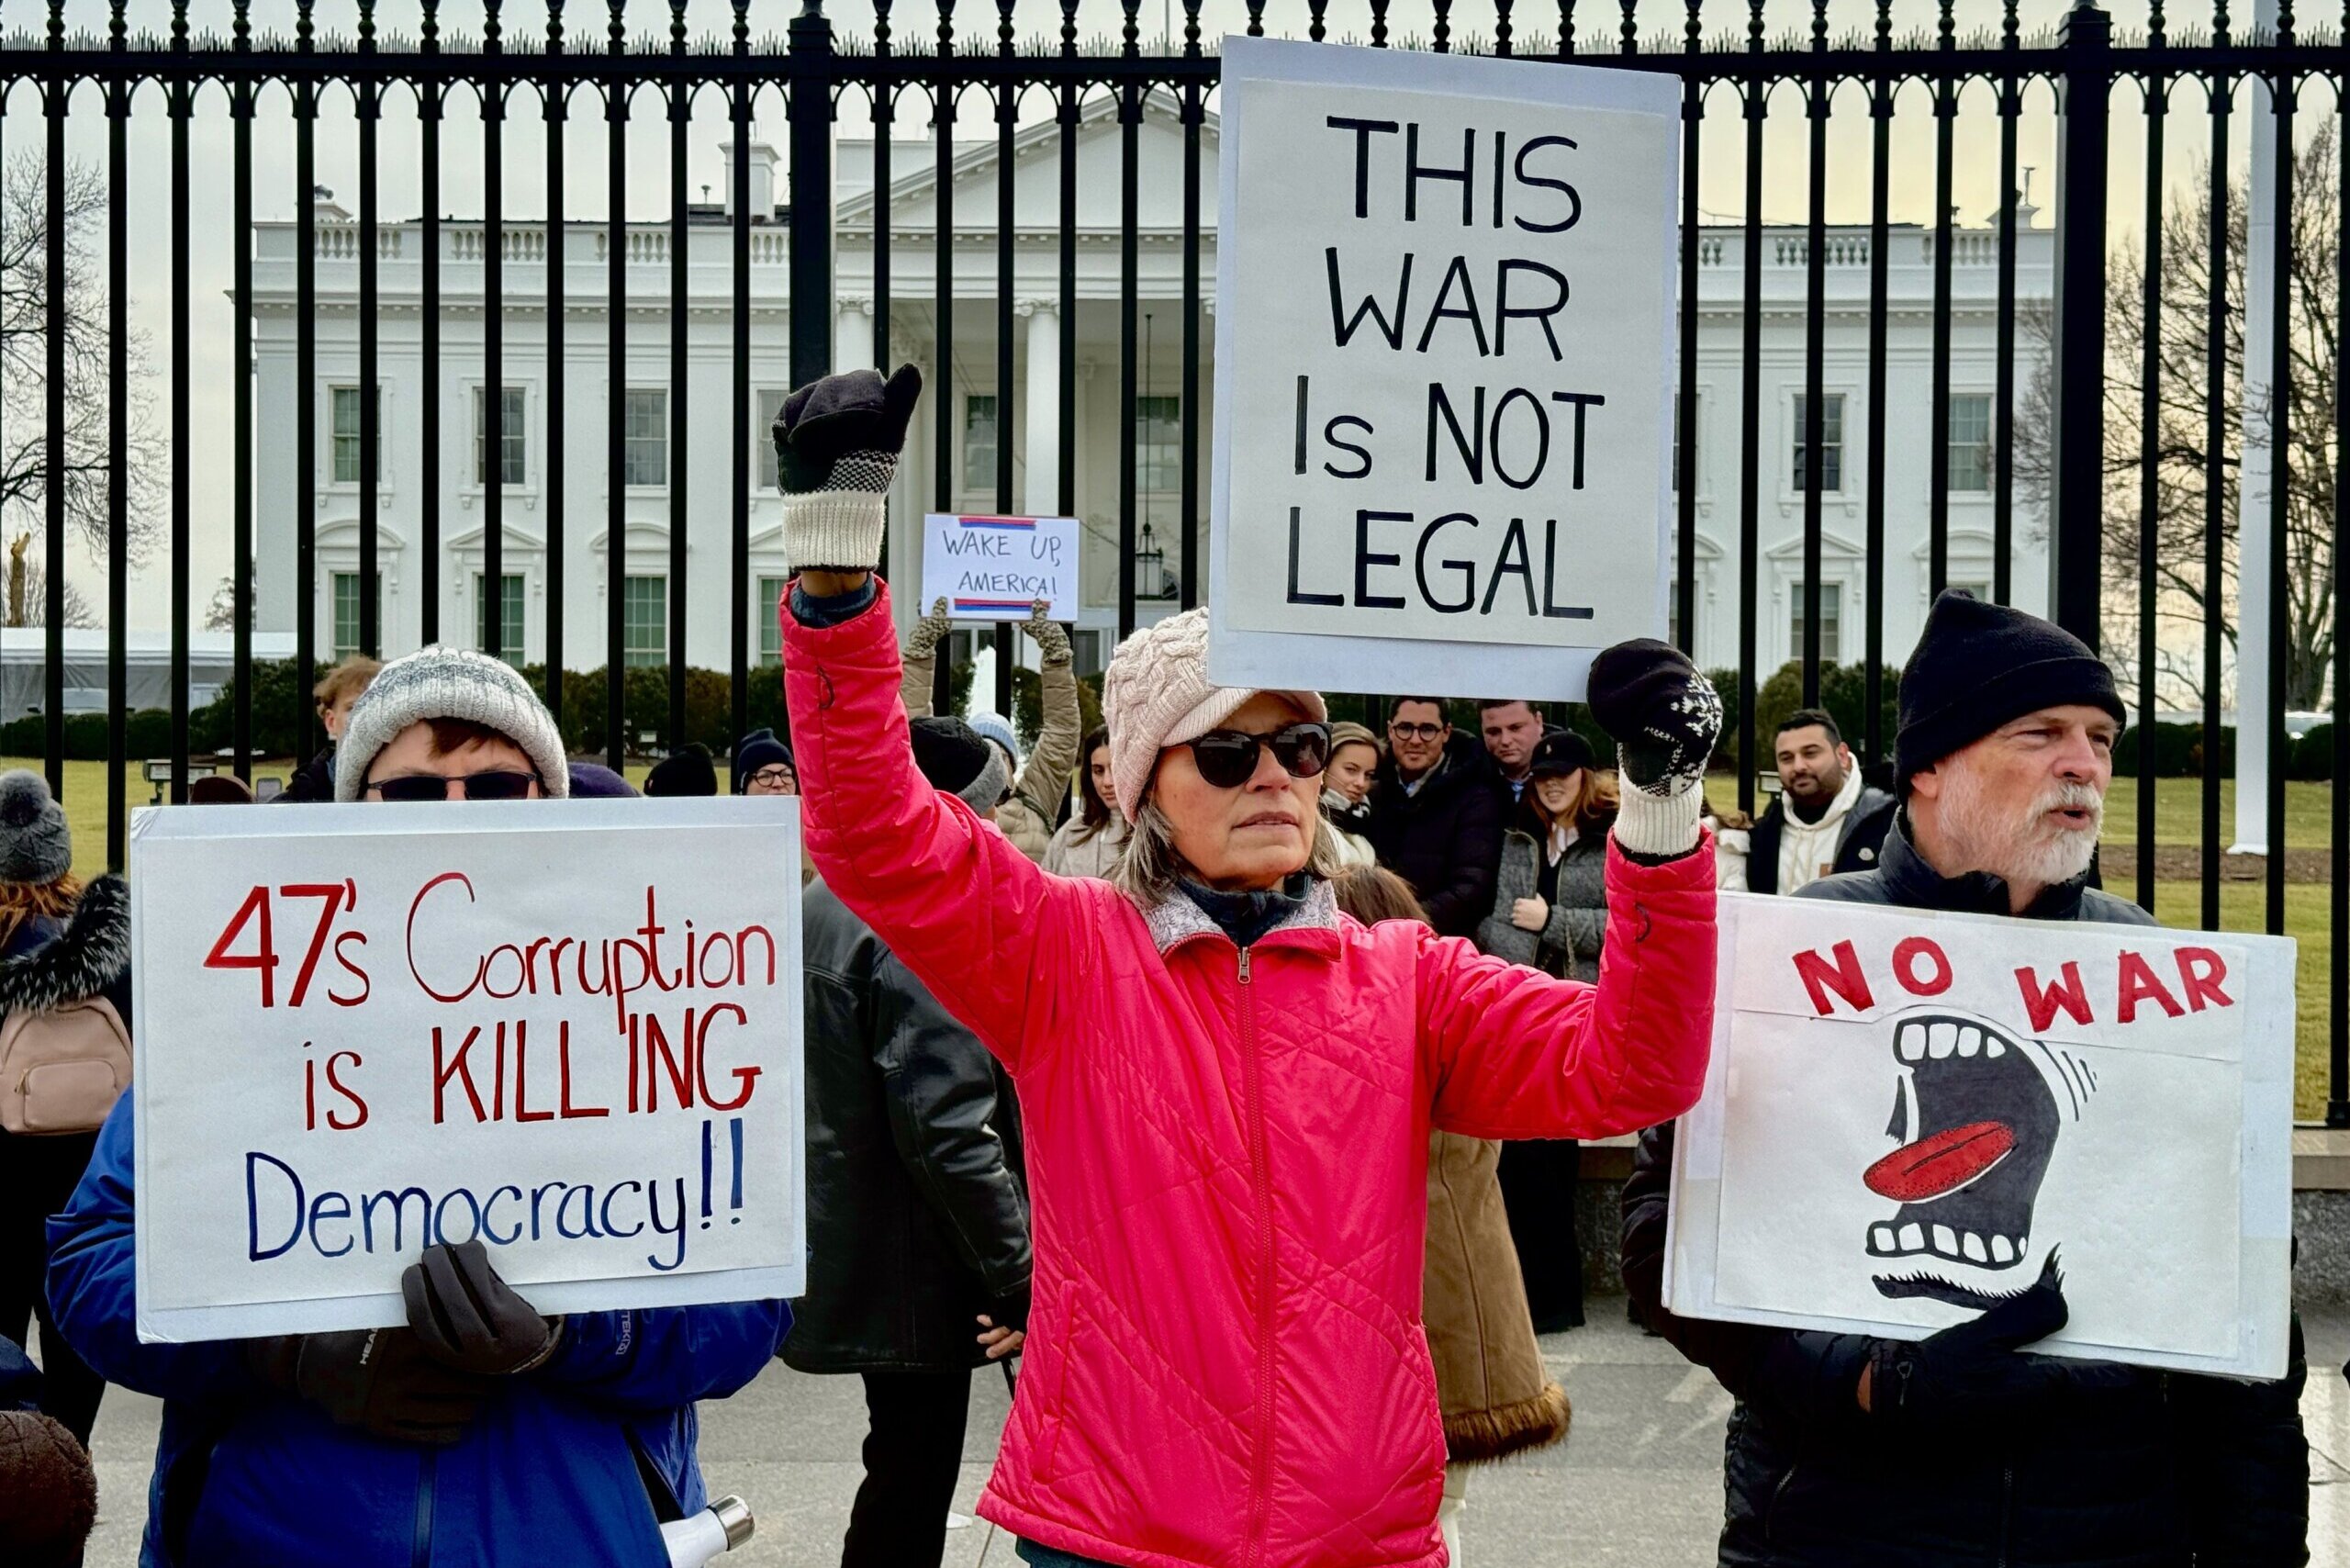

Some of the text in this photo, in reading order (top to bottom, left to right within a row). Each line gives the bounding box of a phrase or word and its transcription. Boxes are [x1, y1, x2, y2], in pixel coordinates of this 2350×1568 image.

[1326, 115, 1582, 234] THIS
[1325, 246, 1570, 363] WAR
[1294, 375, 1606, 490] Is NOT
[942, 530, 1062, 567] WAKE UP,
[957, 570, 1058, 602] AMERICA!
[1286, 506, 1595, 620] LEGAL
[202, 871, 777, 1035] 47's Corruption
[1792, 936, 2235, 1033] NO WAR
[302, 1002, 763, 1131] is KILLING
[245, 1117, 744, 1271] Democracy!!
